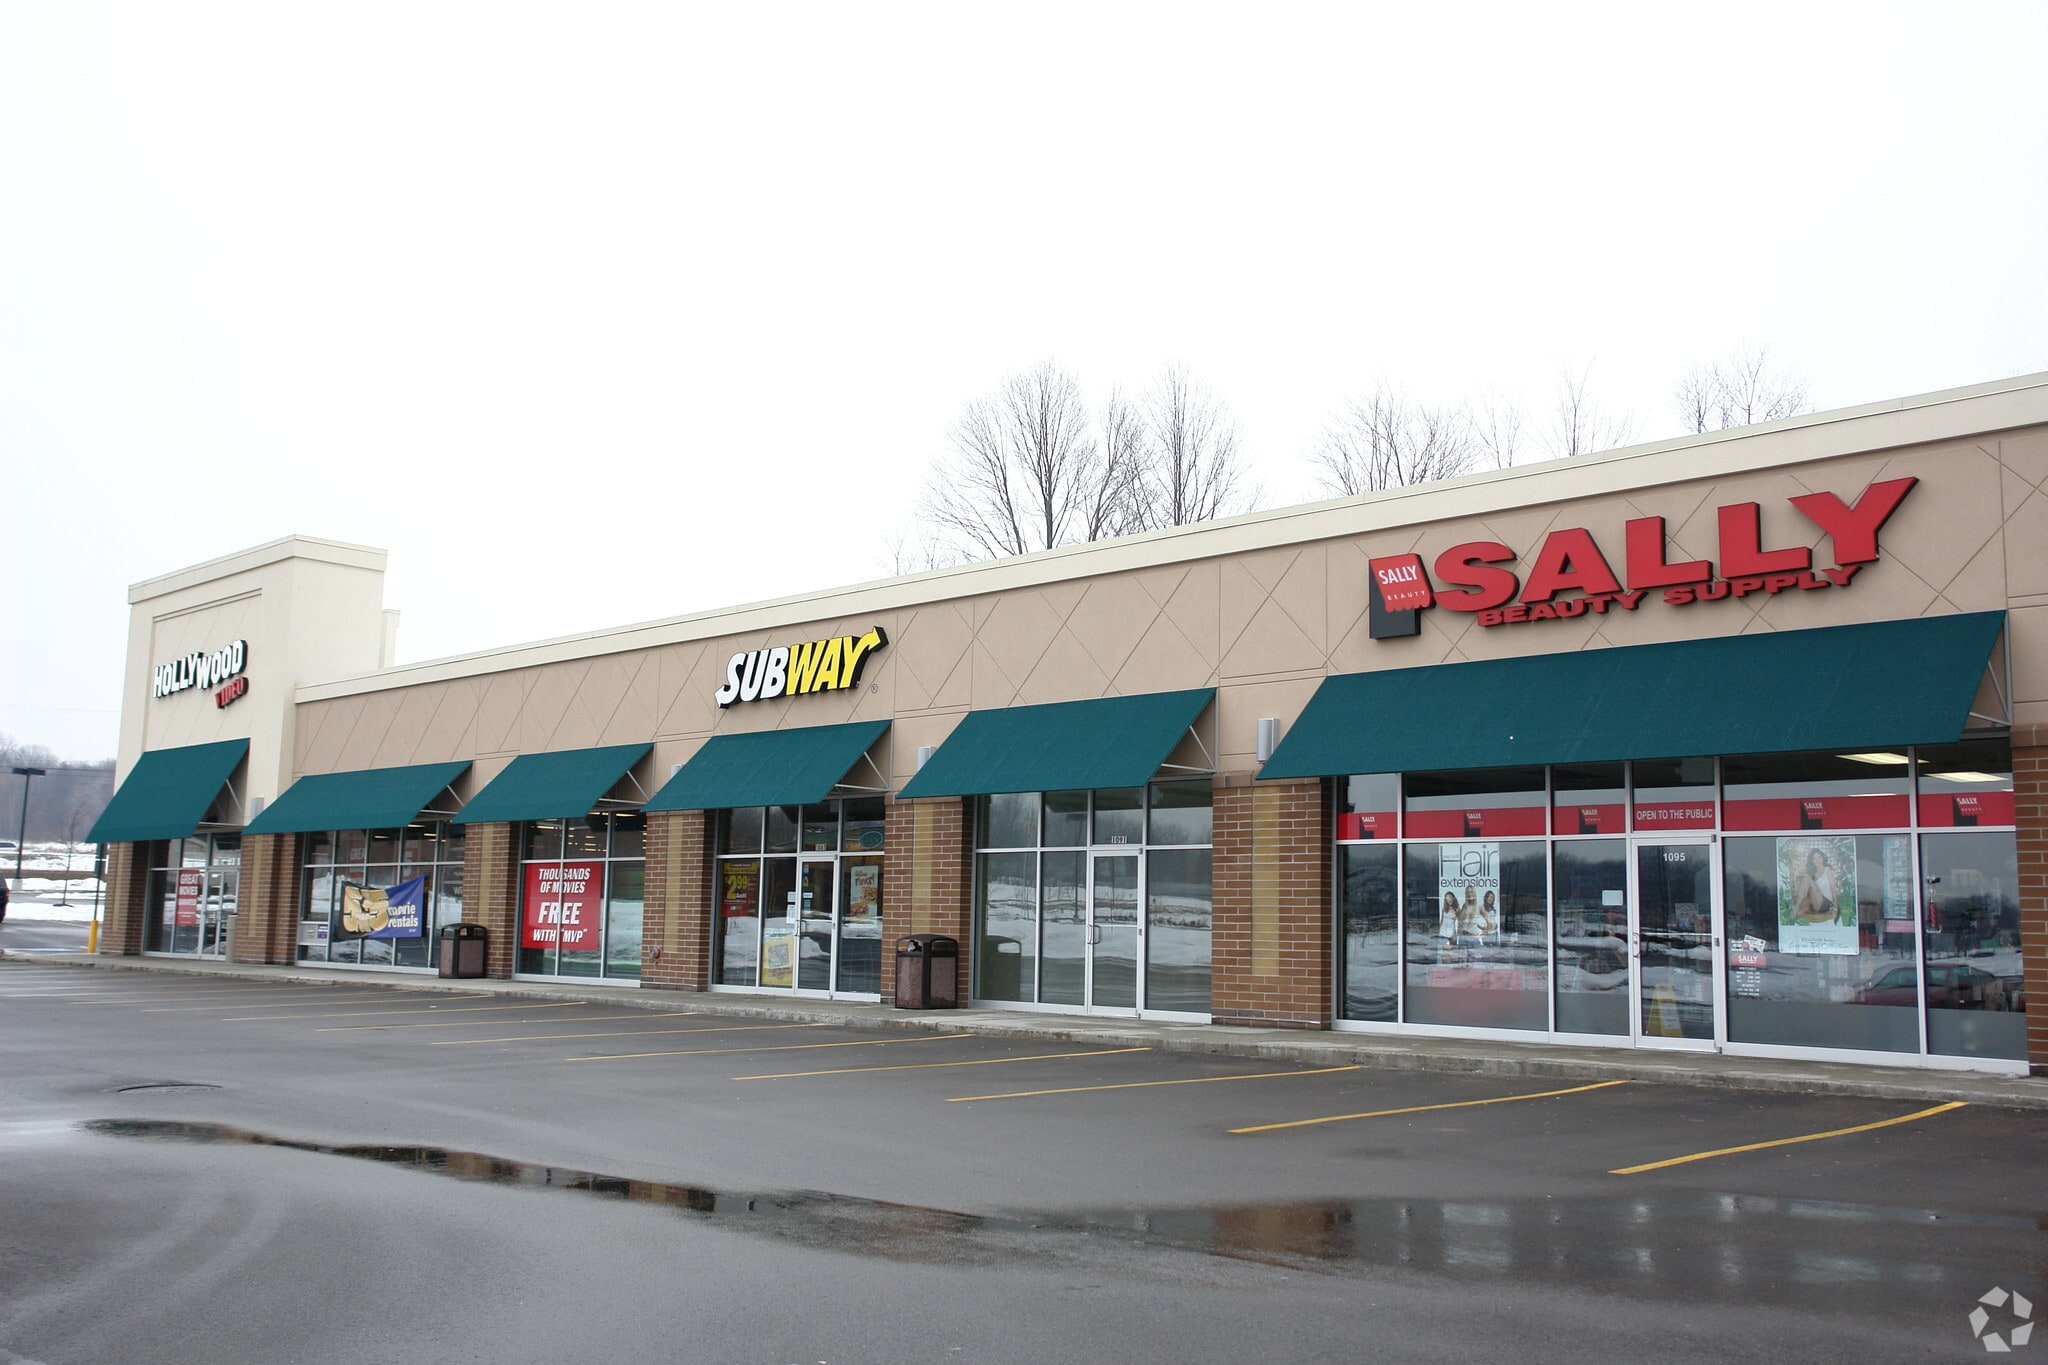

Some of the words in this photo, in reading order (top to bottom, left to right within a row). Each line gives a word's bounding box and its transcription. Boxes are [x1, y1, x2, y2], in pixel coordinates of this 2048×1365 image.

[1434, 476, 1919, 612] SALLY
[1378, 564, 1418, 585] SALLY
[1387, 590, 1425, 601] BEAUTY
[1477, 588, 1648, 627] BEAUTY
[1663, 564, 1864, 605] SUPPLY
[153, 639, 248, 699] HOLLYWOOD
[714, 626, 889, 709] SUBWAY
[214, 676, 249, 709] VIDEO
[1636, 810, 1657, 820] OPEN
[1658, 810, 1668, 819] TO
[1669, 809, 1684, 819] THE
[1685, 808, 1713, 819] PUBLIC
[1440, 844, 1499, 877] Hair
[1662, 852, 1686, 862] 1095
[180, 873, 199, 885] GREAT
[539, 867, 591, 880] THOUSANDS
[540, 881, 552, 894] OF
[552, 881, 586, 894] MOVIES
[1440, 877, 1499, 888] extensions
[388, 901, 417, 917] movie
[538, 902, 583, 925] FREE
[388, 914, 419, 928] rentals
[533, 929, 557, 942] WITH
